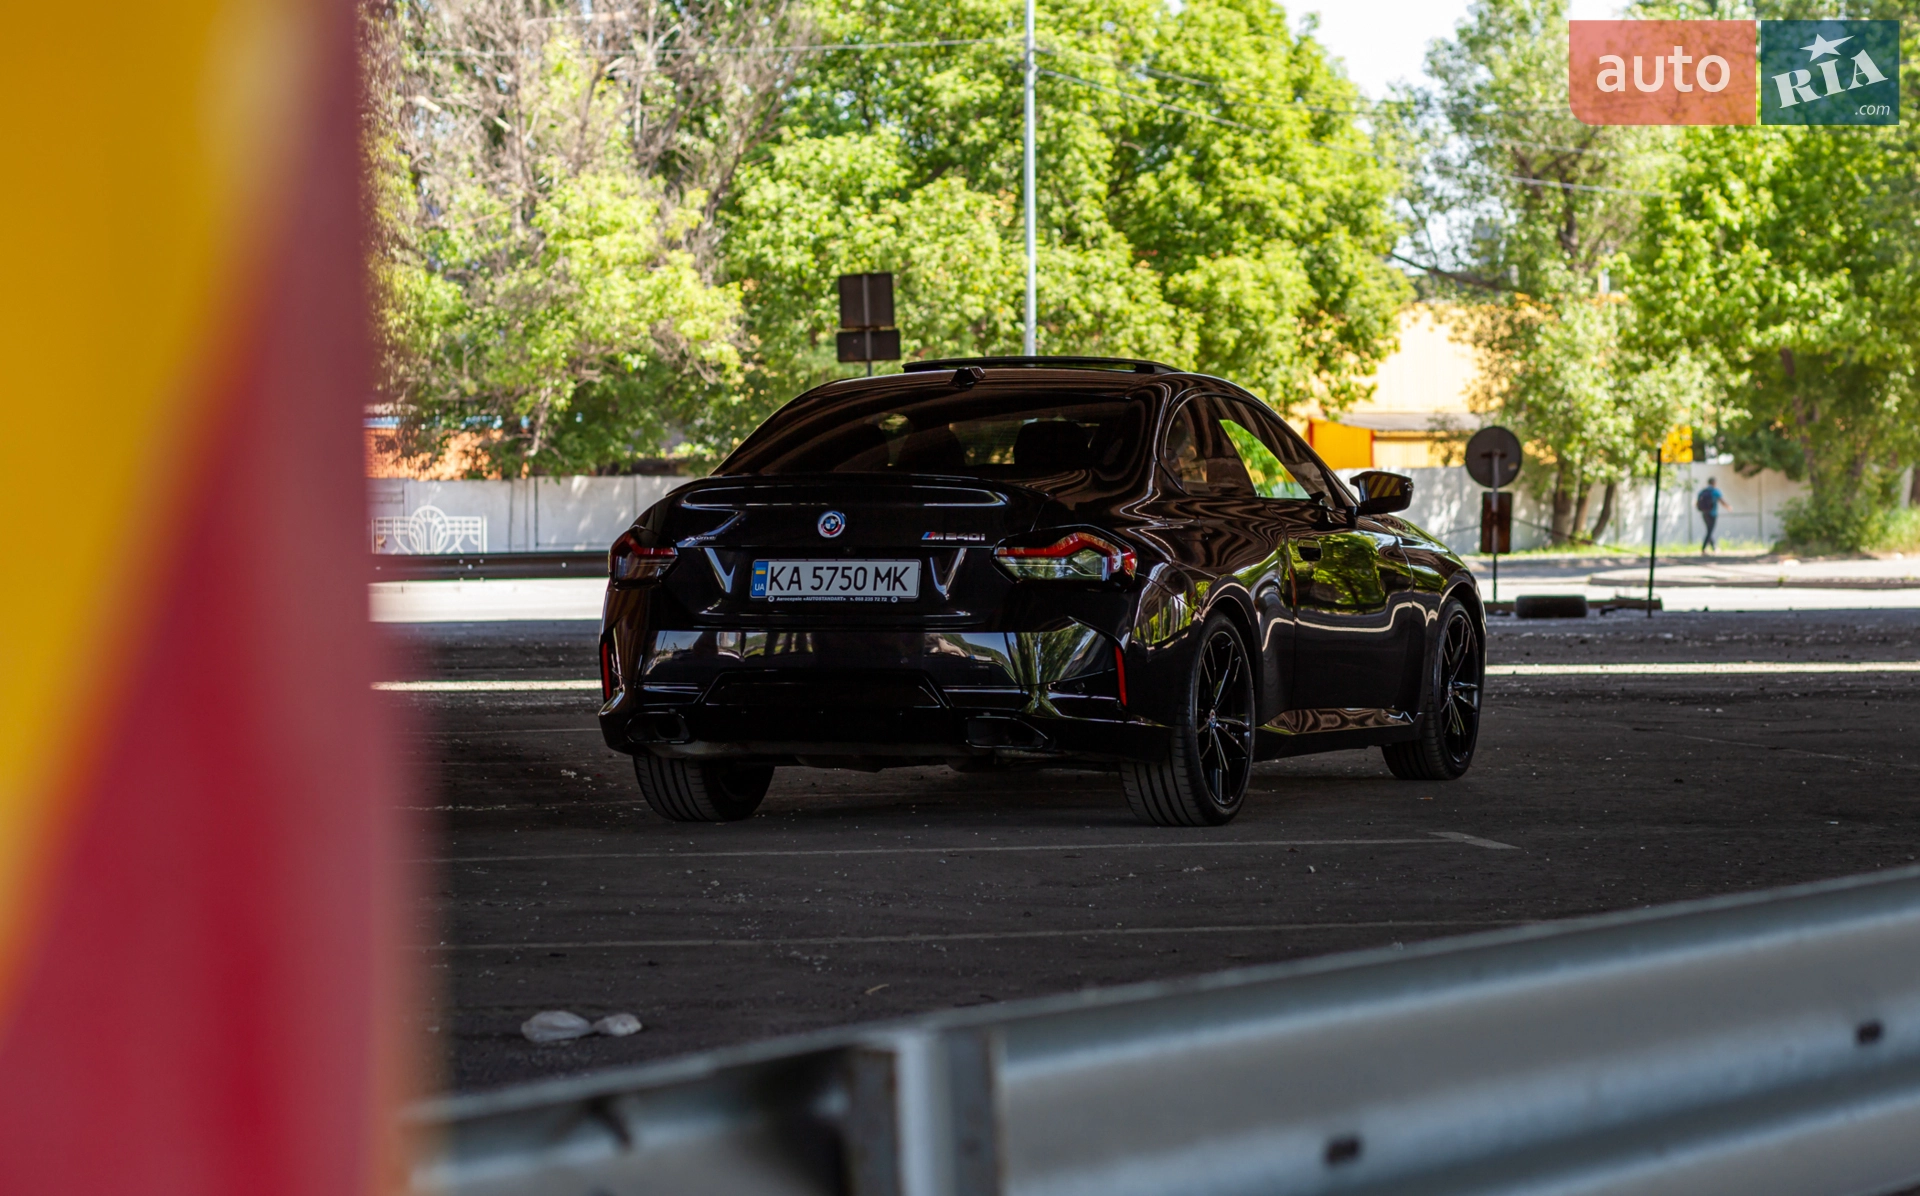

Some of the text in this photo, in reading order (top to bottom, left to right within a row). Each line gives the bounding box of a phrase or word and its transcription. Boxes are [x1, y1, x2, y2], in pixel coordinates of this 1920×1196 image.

[769, 566, 910, 591] KA 5750 MK
[754, 583, 765, 591] UA
